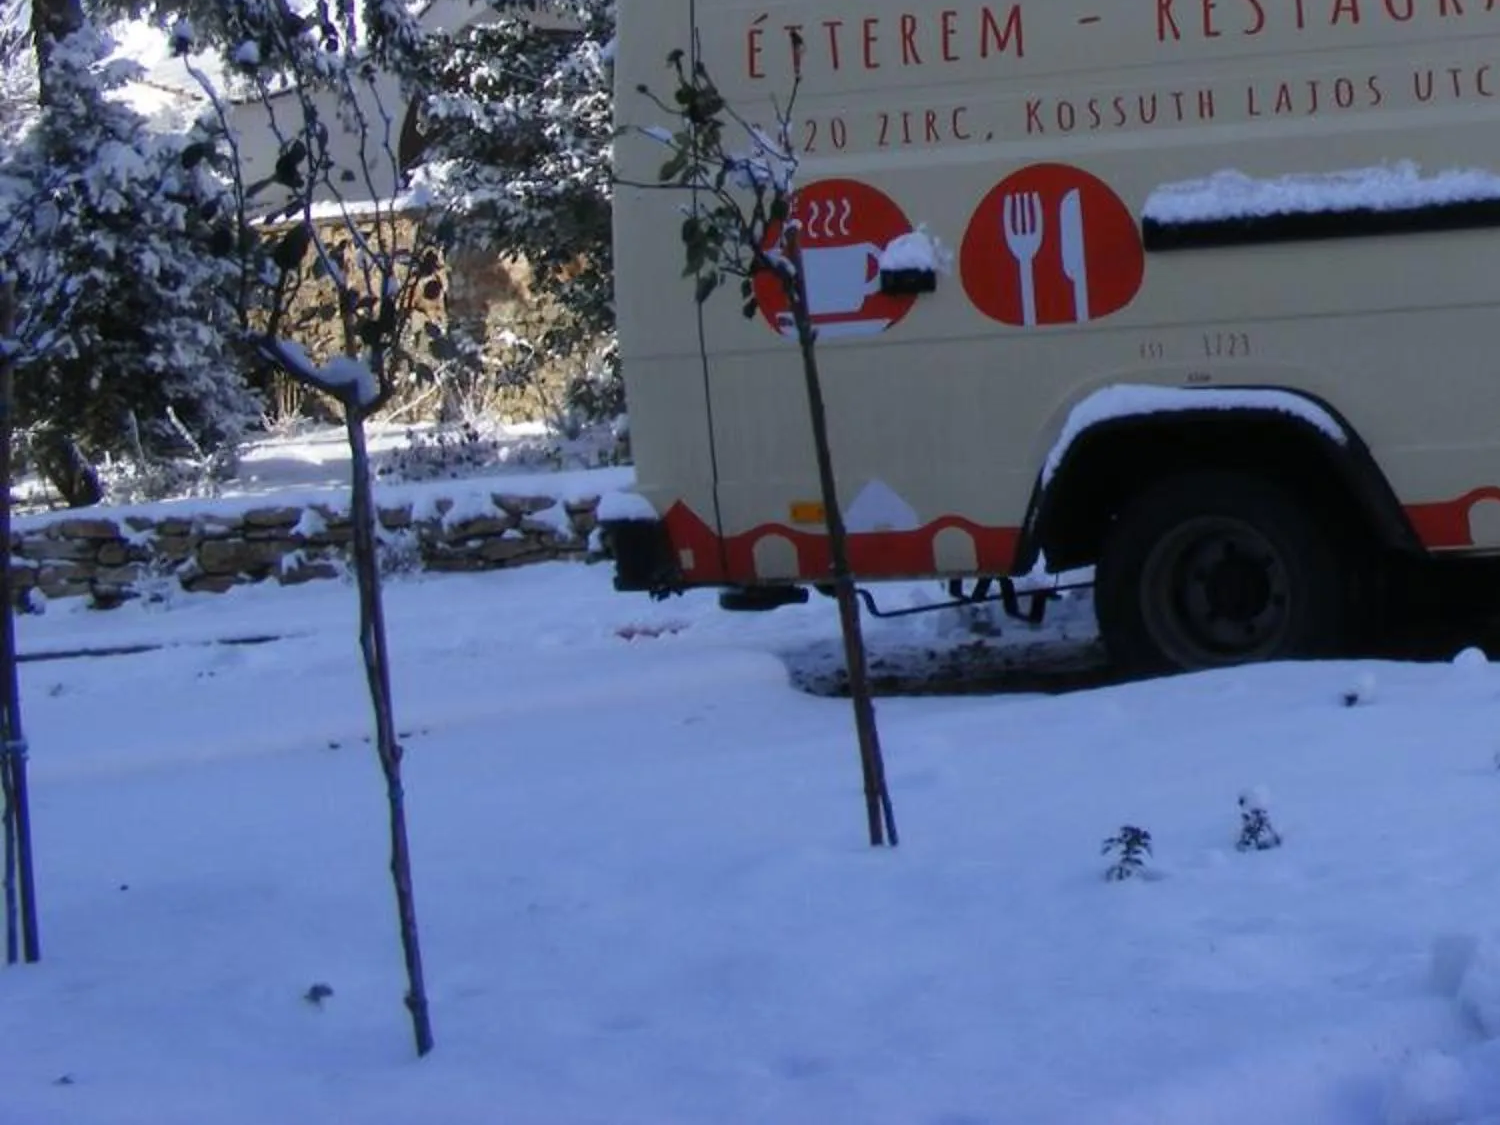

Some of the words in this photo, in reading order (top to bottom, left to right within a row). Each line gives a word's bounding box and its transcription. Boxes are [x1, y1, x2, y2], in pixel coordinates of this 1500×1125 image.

[747, 4, 1025, 79] ÉTTEREM
[877, 108, 992, 148] ZIRC,
[1024, 90, 1215, 135] KOSSUTH
[1246, 76, 1382, 117] LAJOS
